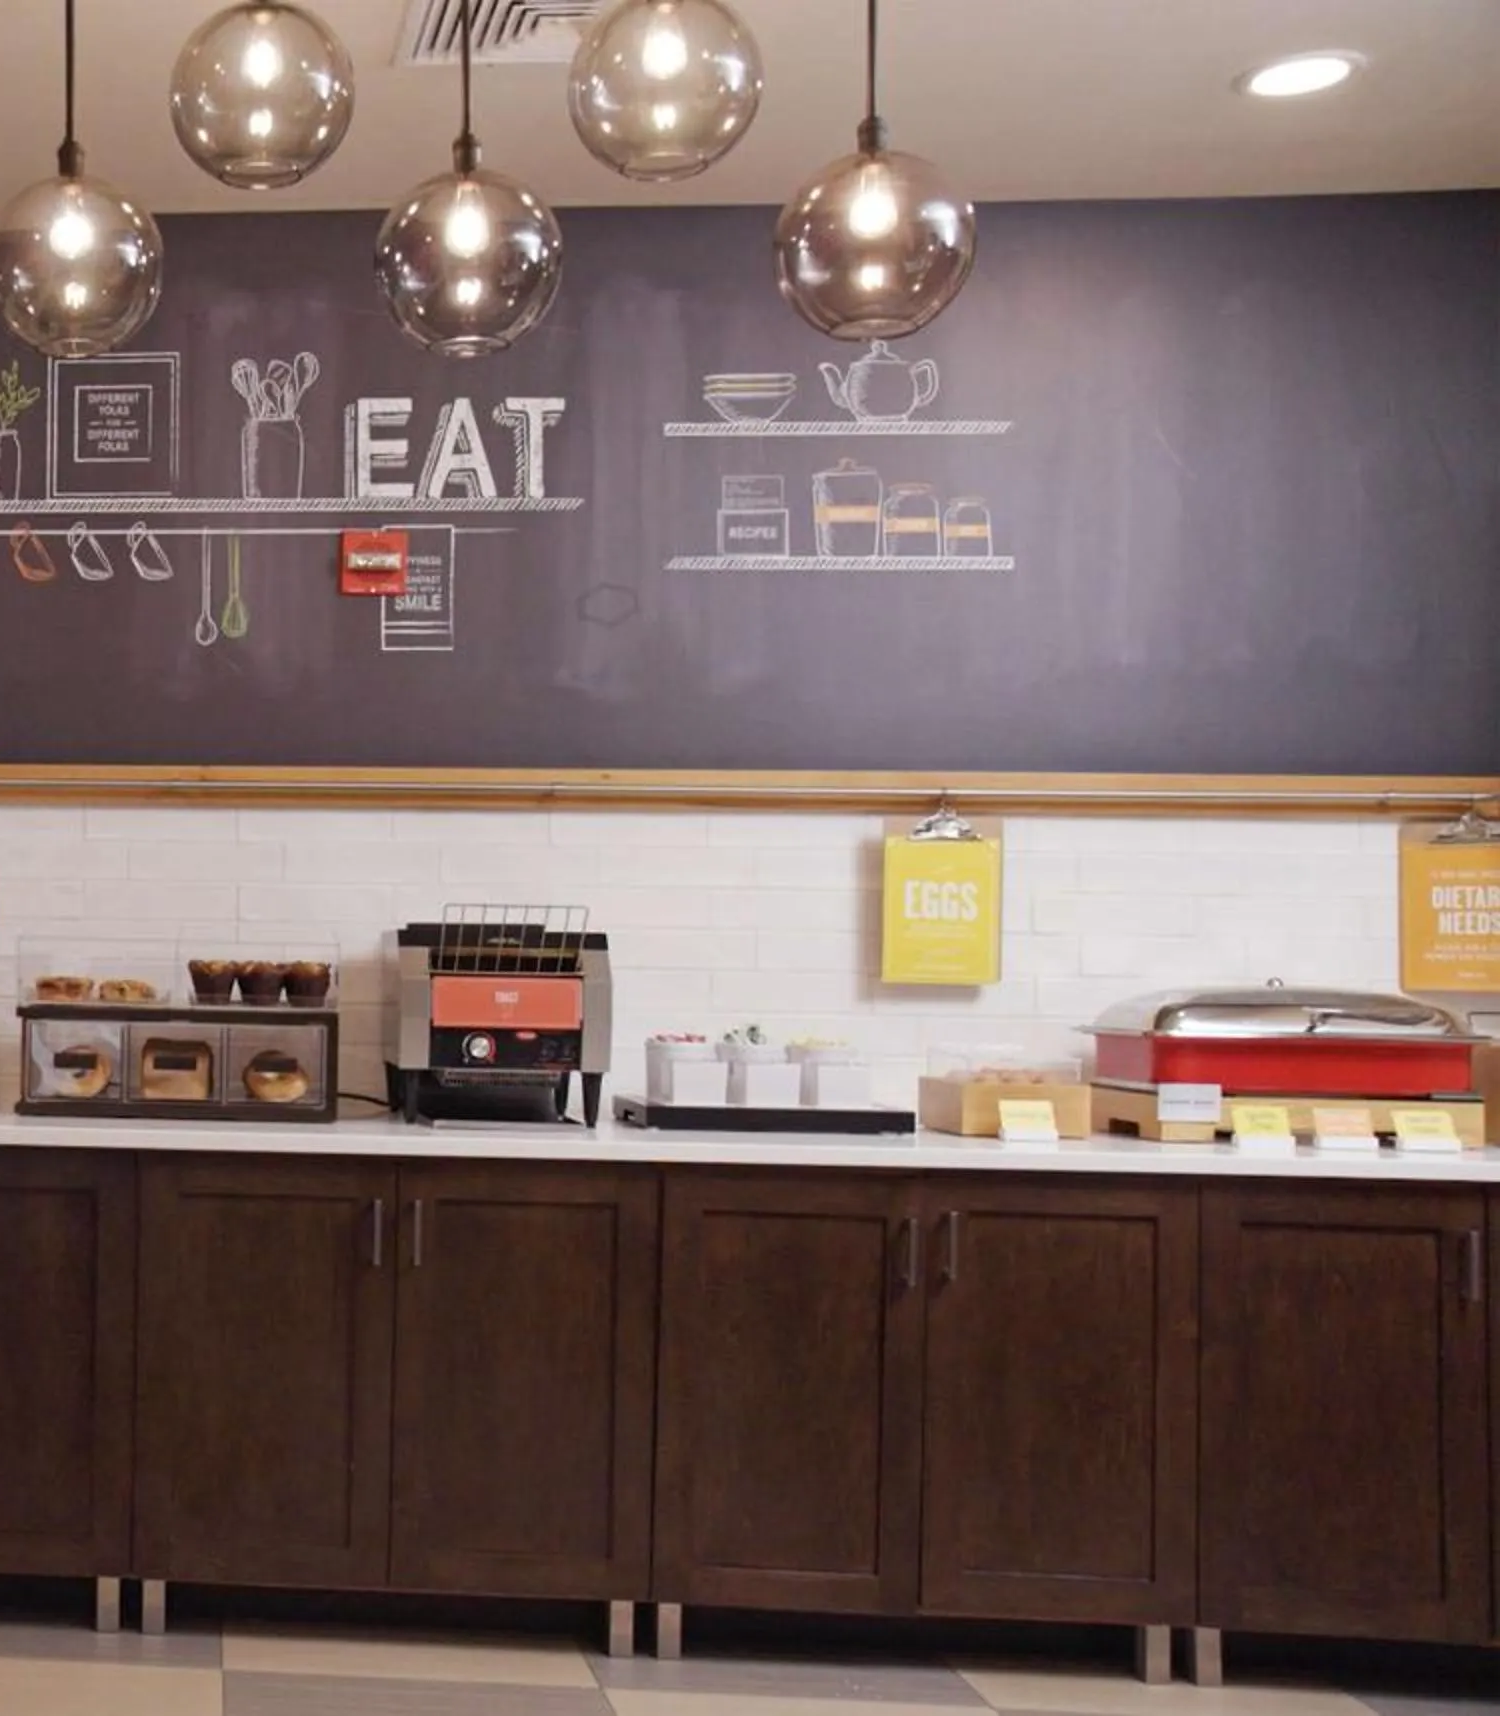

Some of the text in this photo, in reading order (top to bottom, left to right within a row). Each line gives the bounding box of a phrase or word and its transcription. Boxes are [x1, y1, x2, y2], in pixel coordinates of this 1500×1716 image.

[344, 397, 566, 499] EAT
[394, 594, 442, 612] SMILE
[903, 879, 979, 921] EGGS
[1432, 886, 1500, 910] DIETAR
[1439, 911, 1500, 935] NEEDS
